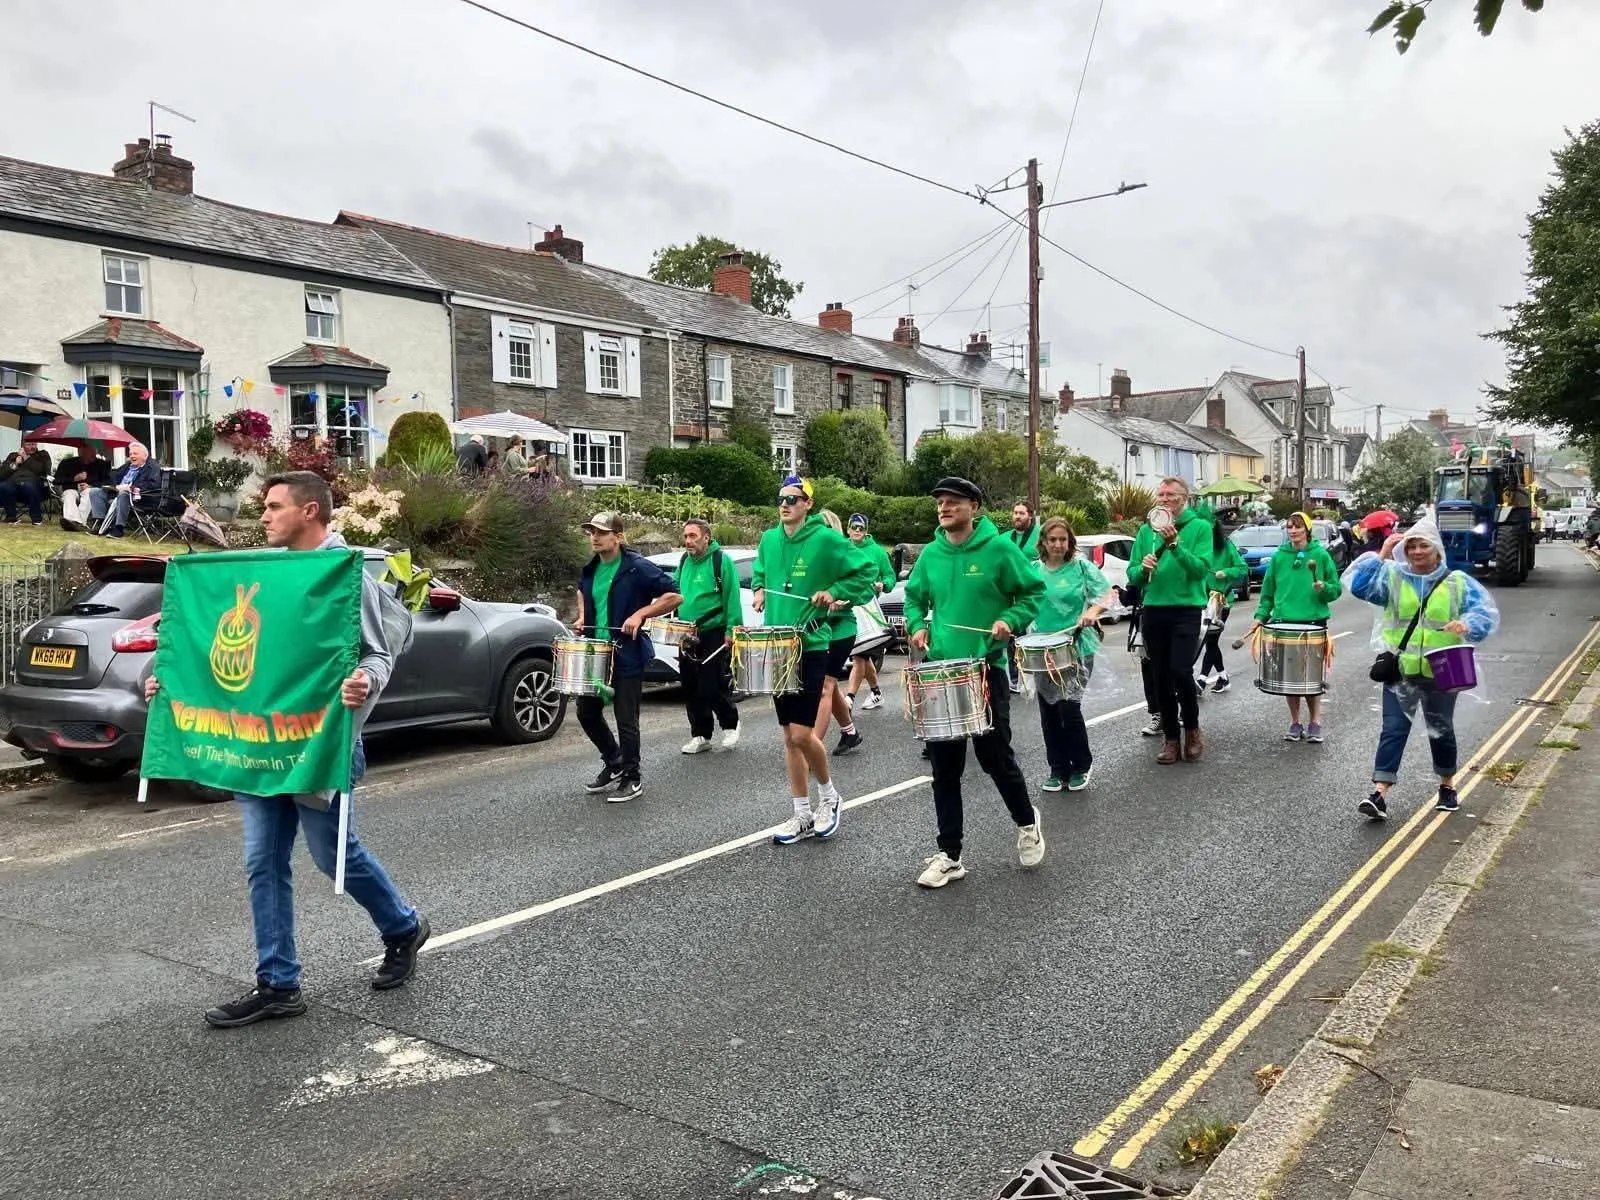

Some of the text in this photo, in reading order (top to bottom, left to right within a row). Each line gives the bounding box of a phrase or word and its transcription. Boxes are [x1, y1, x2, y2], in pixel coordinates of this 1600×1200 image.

[34, 649, 73, 664] WK68 HKW
[206, 745, 224, 761] The
[243, 754, 269, 769] Drum
[271, 756, 285, 770] In
